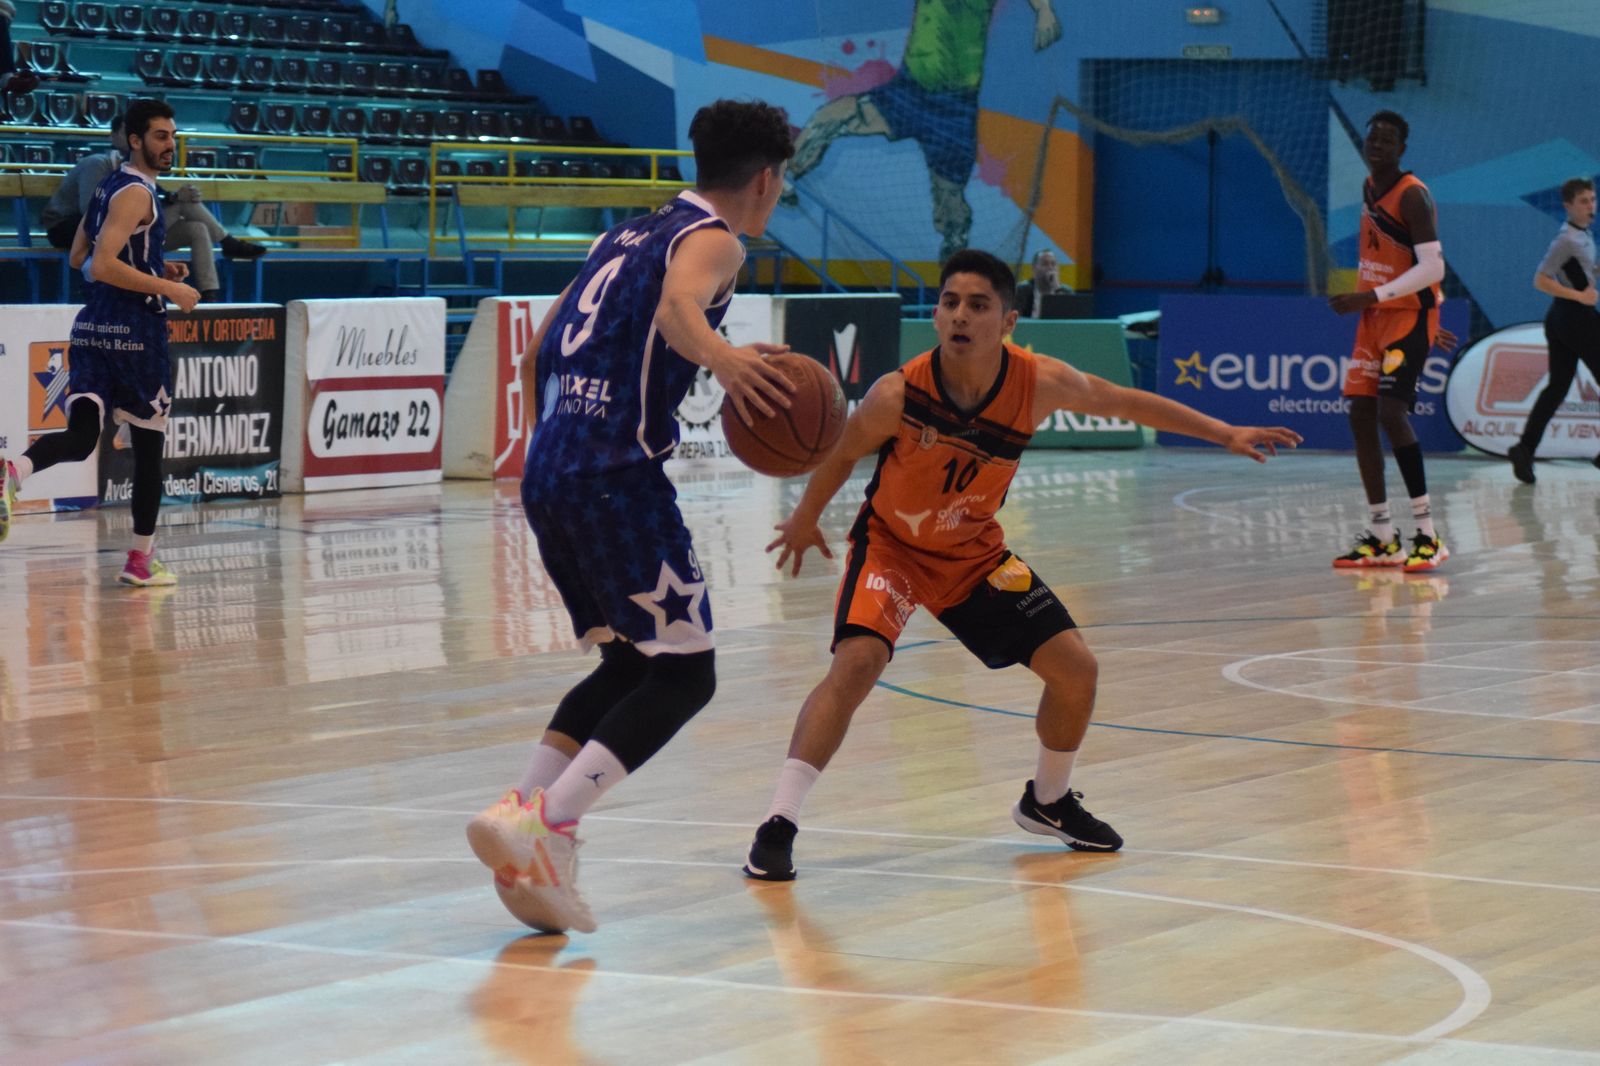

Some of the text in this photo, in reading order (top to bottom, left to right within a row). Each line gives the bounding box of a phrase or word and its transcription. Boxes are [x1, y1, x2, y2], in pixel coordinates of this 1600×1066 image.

[561, 254, 626, 357] 9
[73, 321, 131, 334] yuntamiento
[114, 338, 145, 351] Reina
[203, 319, 212, 342] Y
[213, 318, 276, 342] ORTOPEDIA
[336, 324, 418, 369] Muebles
[175, 355, 259, 399] ANTONIO
[162, 403, 271, 458] HERNÁNDEZ
[322, 399, 430, 450] Gamazo 22
[1462, 420, 1524, 437] ALQUIL
[1551, 423, 1562, 438] Y
[162, 471, 200, 496] denal
[203, 470, 264, 495] Cisneros,
[942, 457, 979, 494] 10
[688, 549, 701, 580] 9
